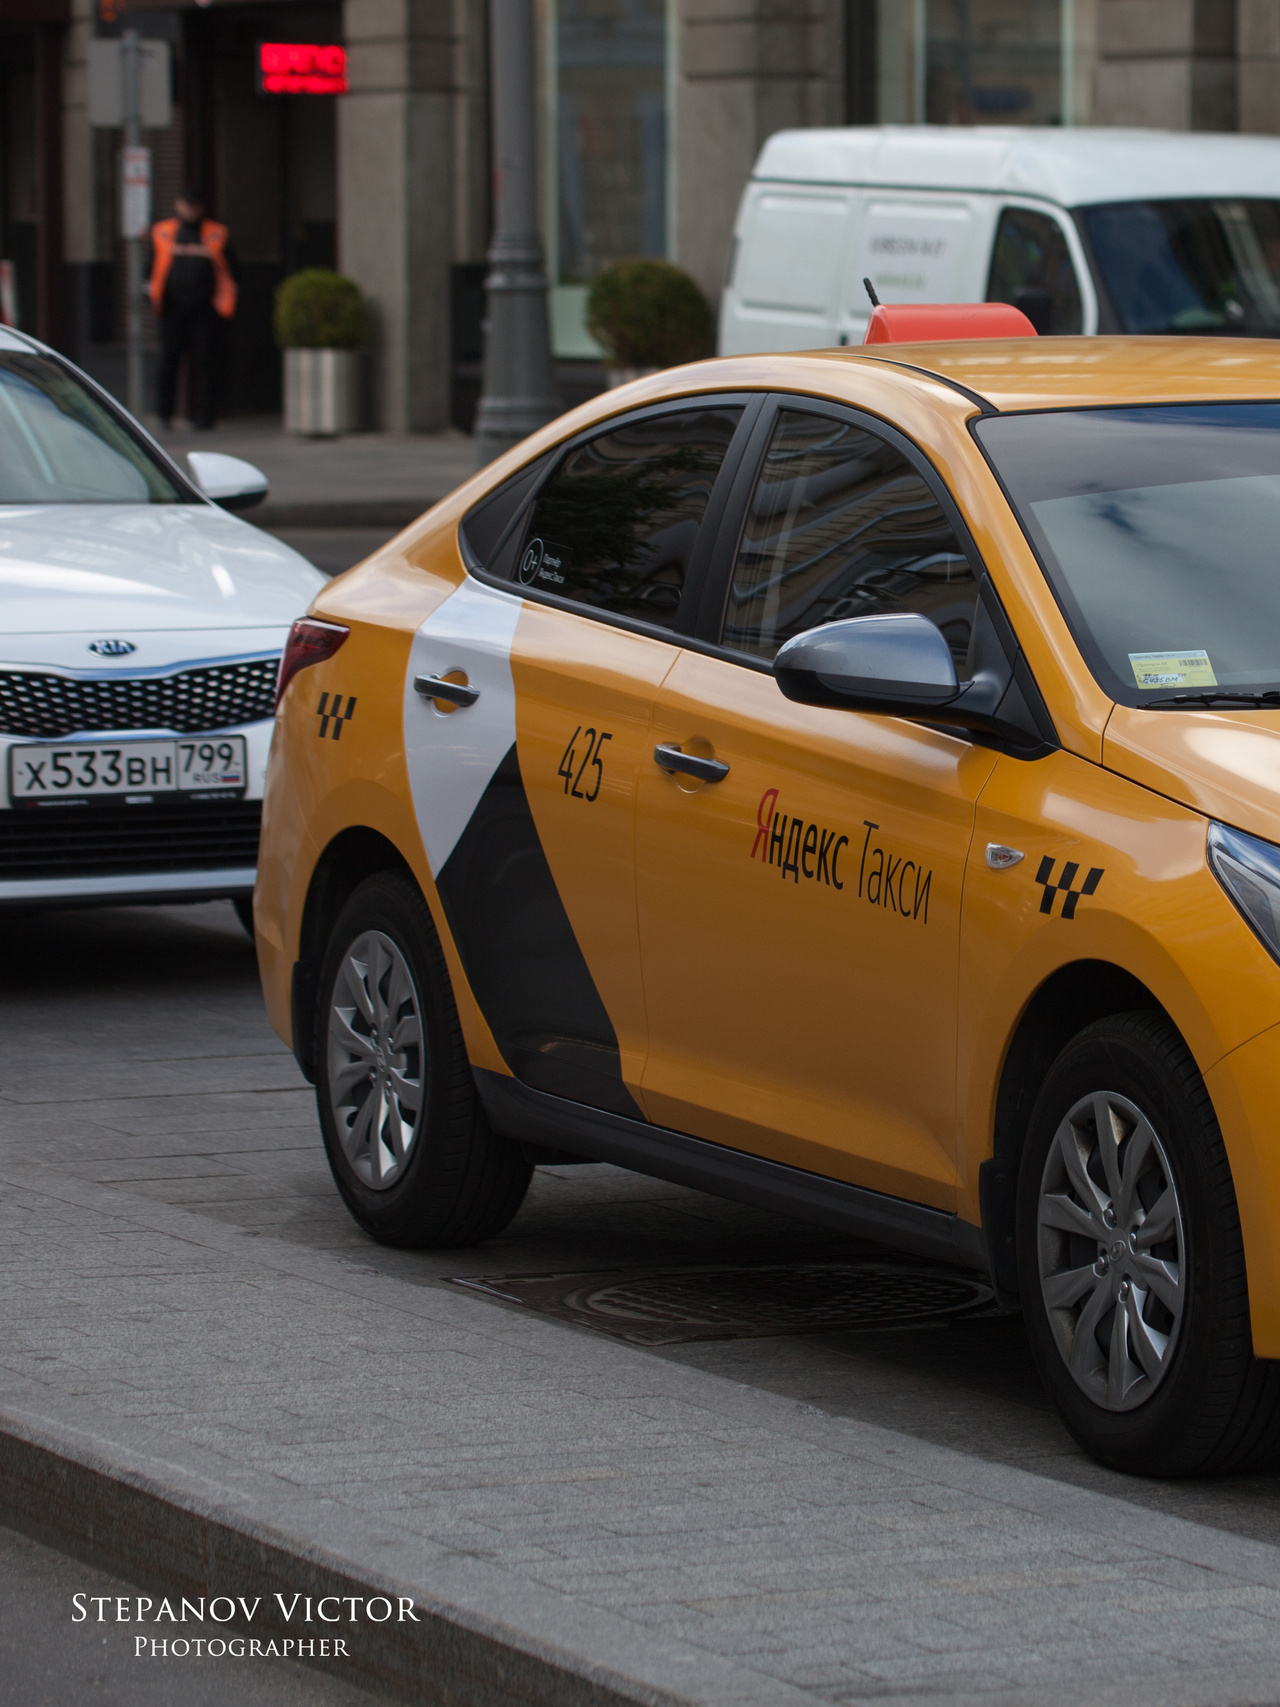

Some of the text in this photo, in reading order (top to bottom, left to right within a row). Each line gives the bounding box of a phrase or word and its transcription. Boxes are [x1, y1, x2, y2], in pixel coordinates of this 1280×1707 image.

[94, 641, 131, 654] KIA
[25, 742, 235, 790] Х533ВН 799
[193, 773, 221, 784] RUS
[557, 725, 613, 802] 425
[750, 788, 932, 925] Яндекс Такси
